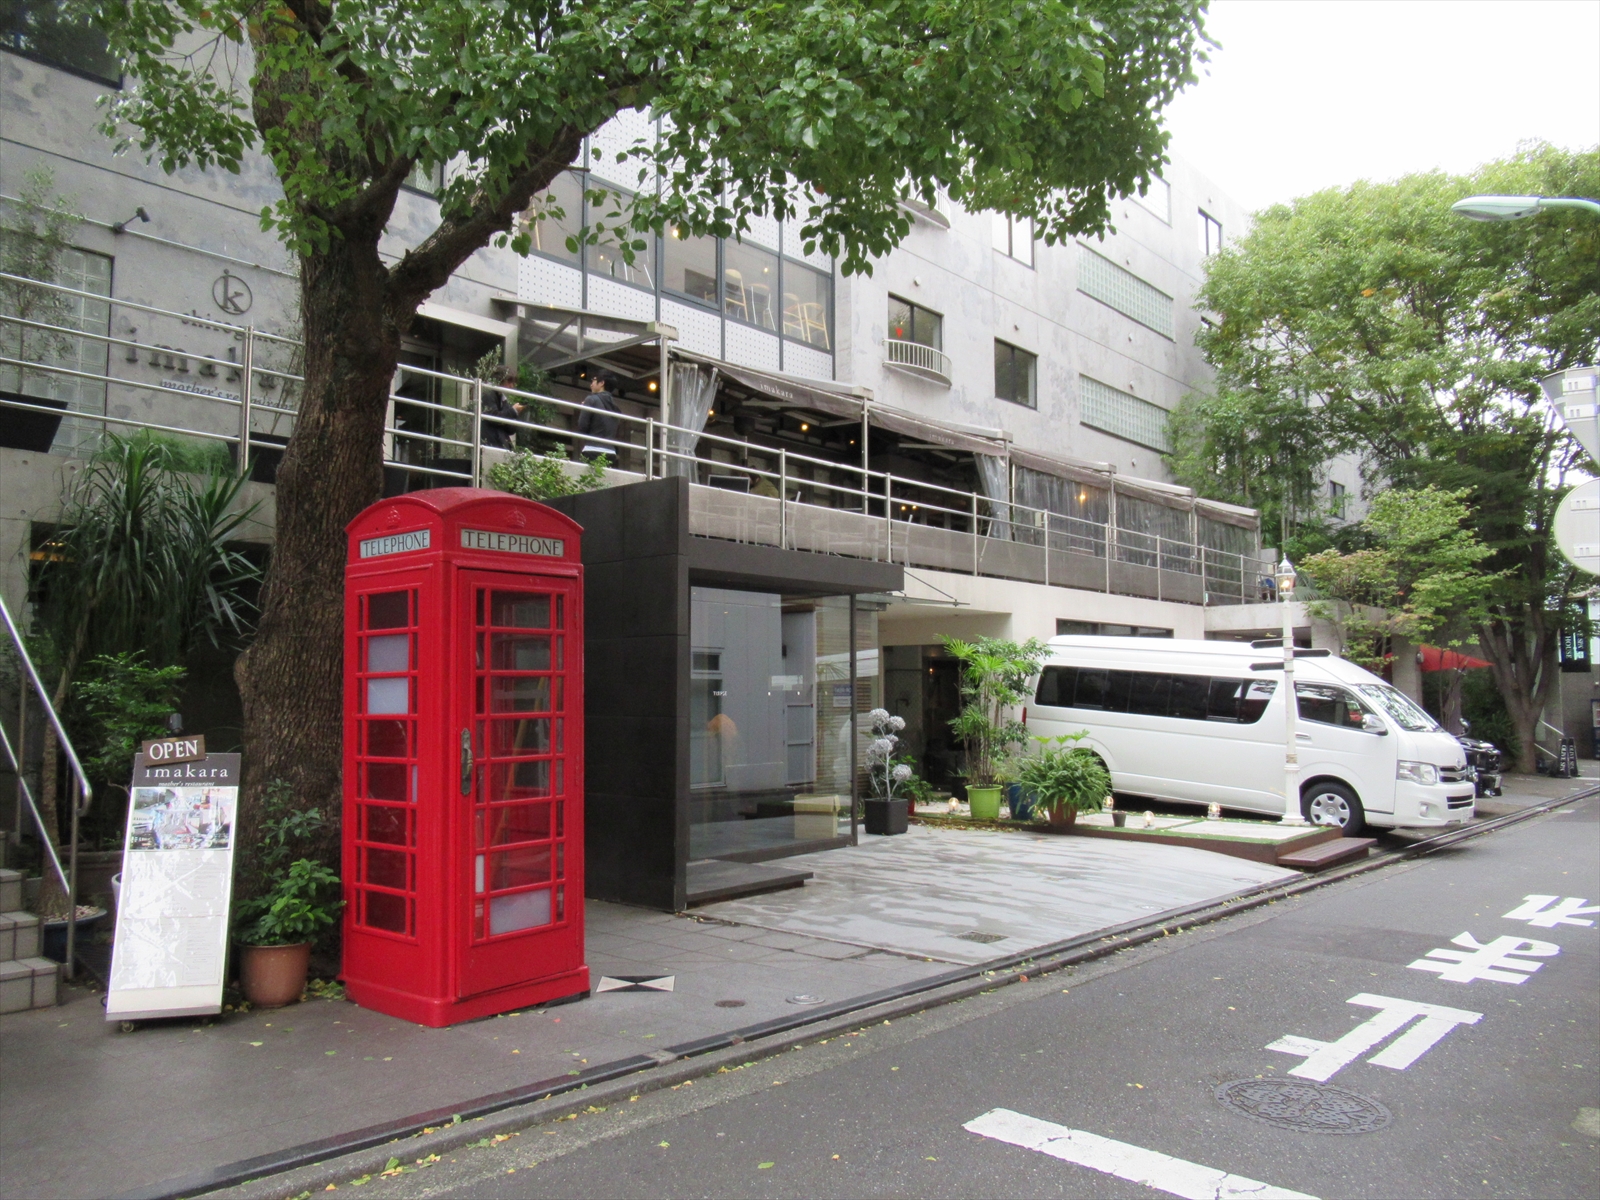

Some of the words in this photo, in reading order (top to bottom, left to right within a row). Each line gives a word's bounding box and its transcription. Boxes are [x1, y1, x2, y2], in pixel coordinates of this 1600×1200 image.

[759, 381, 794, 399] imakara
[363, 530, 429, 557] TELEPHONE
[464, 530, 562, 556] TELEPHONE
[149, 740, 198, 760] OPEN
[145, 764, 229, 778] imakara
